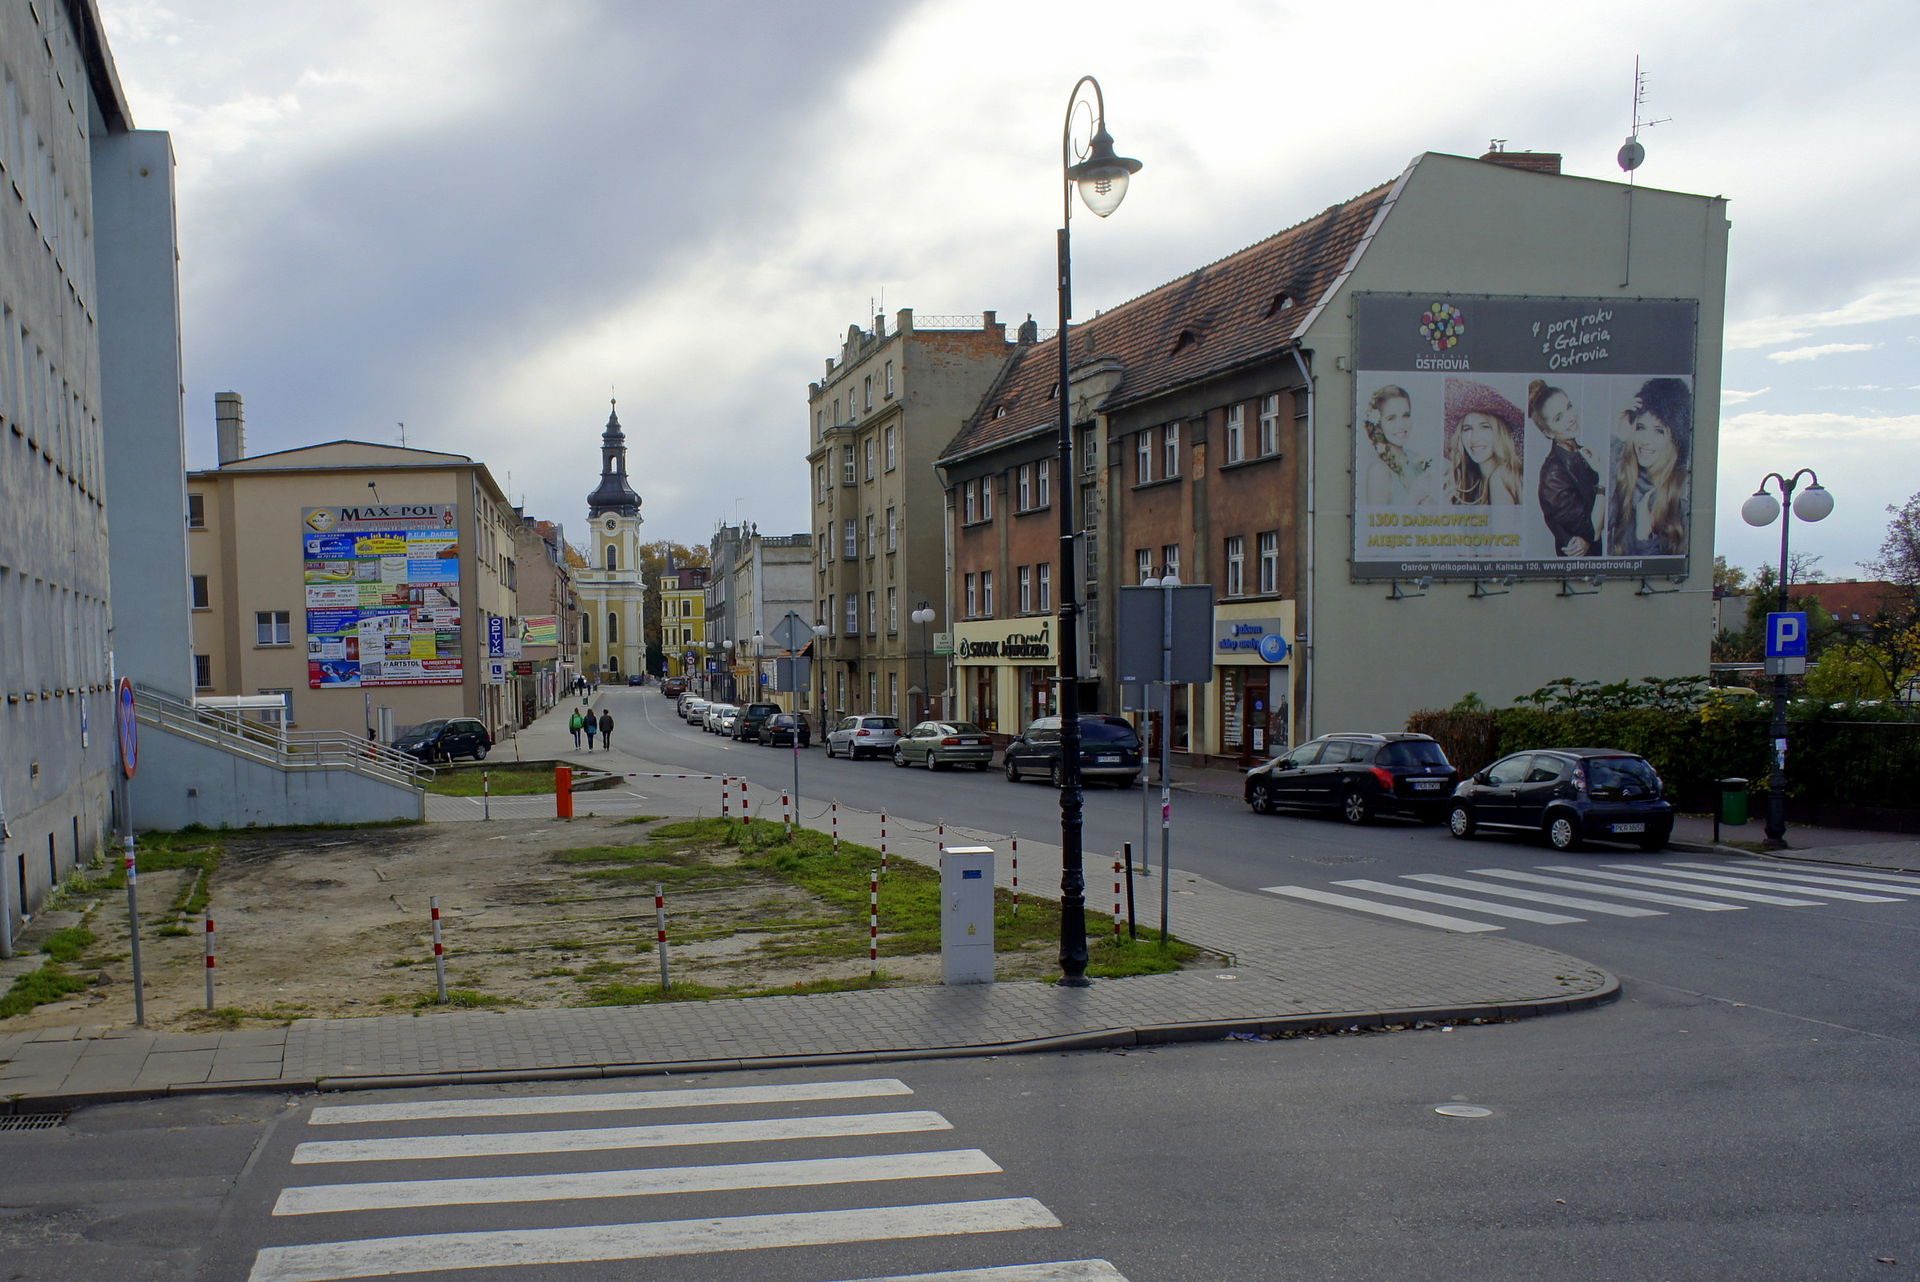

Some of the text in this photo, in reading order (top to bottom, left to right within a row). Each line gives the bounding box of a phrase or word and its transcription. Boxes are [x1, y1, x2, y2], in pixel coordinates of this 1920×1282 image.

[1532, 307, 1613, 340] 4 pory roku
[1542, 342, 1550, 354] z
[1415, 359, 1470, 370] OSTROVIA
[1549, 346, 1609, 370] Ostrovia
[340, 506, 438, 521] MAX-POL
[1367, 513, 1489, 527] 1300 DARMOWYCH
[1367, 534, 1521, 548] MIEJSC PARKINGOWYCH
[1401, 562, 1429, 571] Ostrów
[1430, 563, 1482, 572] Wielkopolski,
[1543, 560, 1643, 571] www.galeriaostrovia.pl
[490, 618, 501, 653] OPTYK
[1776, 618, 1799, 652] P
[969, 641, 999, 657] SKOK
